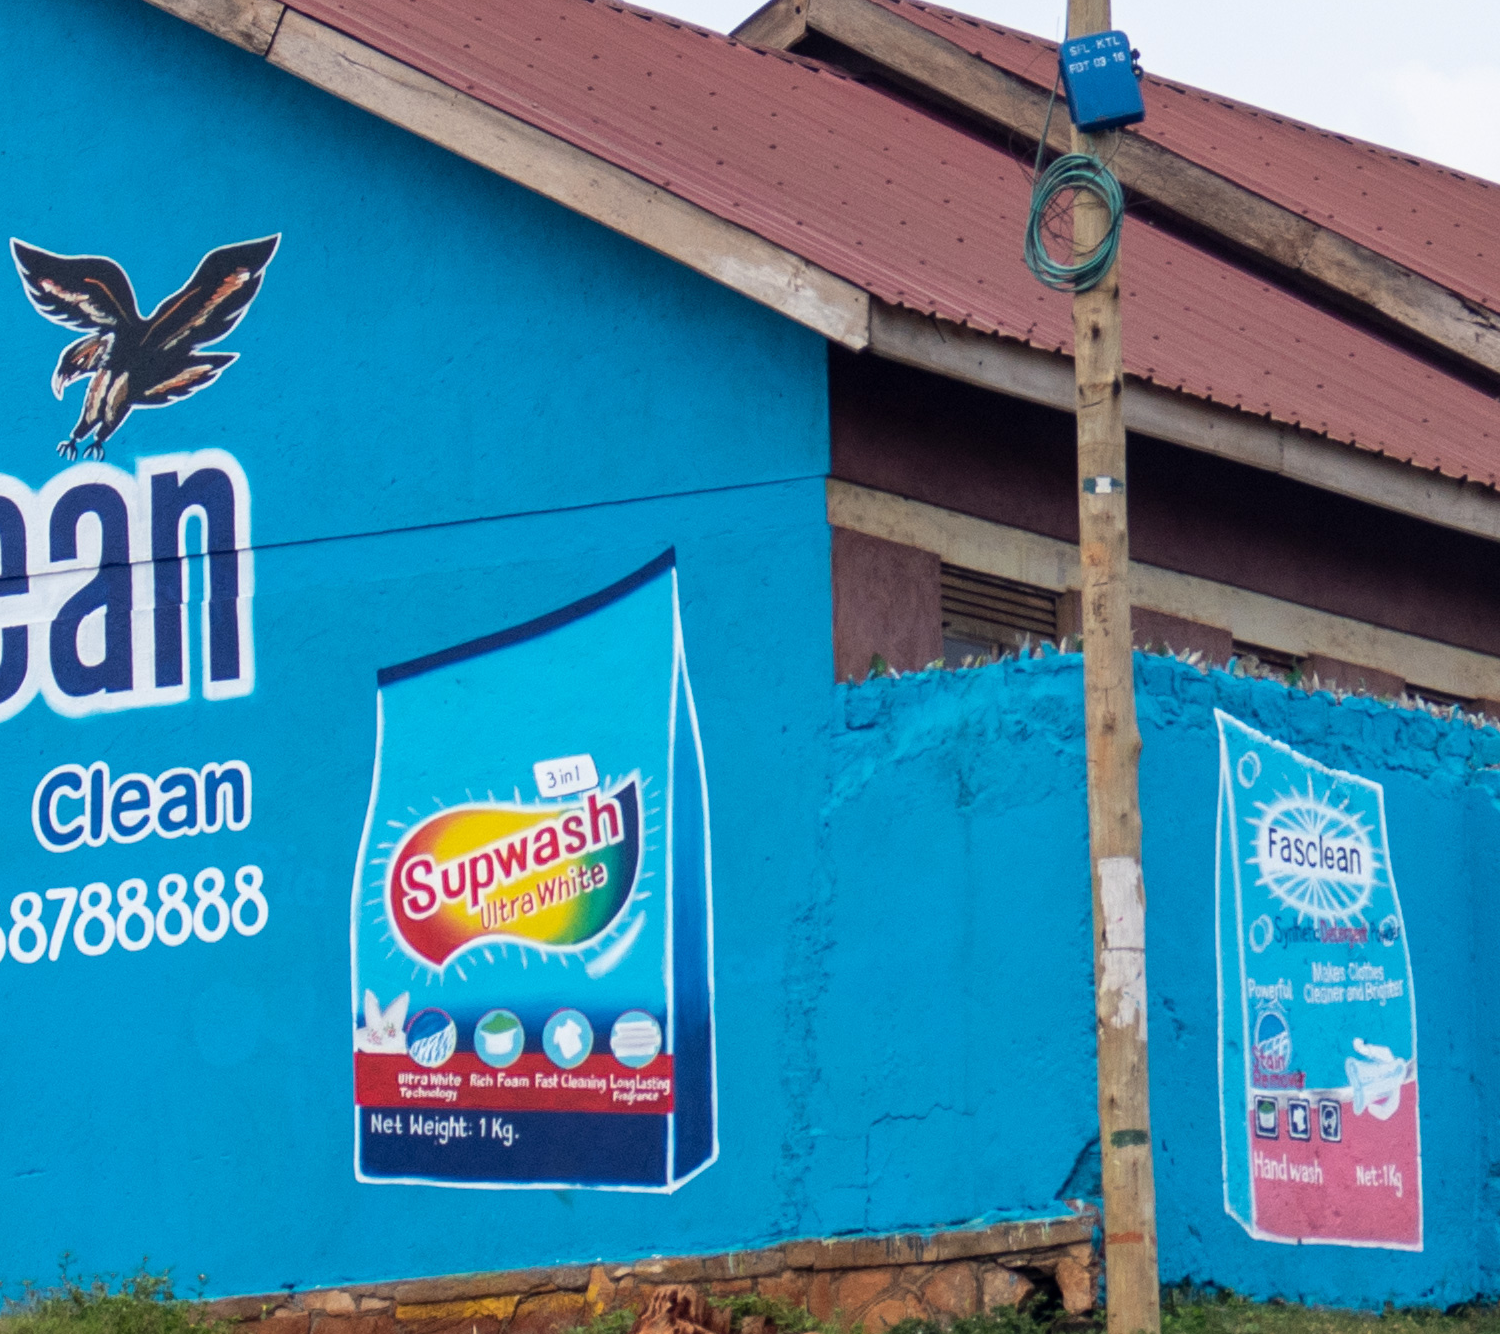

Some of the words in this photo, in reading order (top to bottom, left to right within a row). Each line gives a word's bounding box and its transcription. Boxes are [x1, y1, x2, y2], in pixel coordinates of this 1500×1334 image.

[31, 760, 252, 853] Clean
[402, 790, 623, 917] Supwash
[1268, 826, 1362, 875] Fasclean
[480, 893, 534, 931] Ultra
[536, 862, 608, 908] White
[430, 1073, 462, 1087] White
[470, 1074, 494, 1088] Rich
[497, 1074, 529, 1088] Foam
[535, 1074, 558, 1089] Fast
[561, 1073, 606, 1093] Cleaning
[399, 1088, 457, 1102] Technology
[371, 1114, 402, 1135] Net
[1253, 1150, 1287, 1181] Hand
